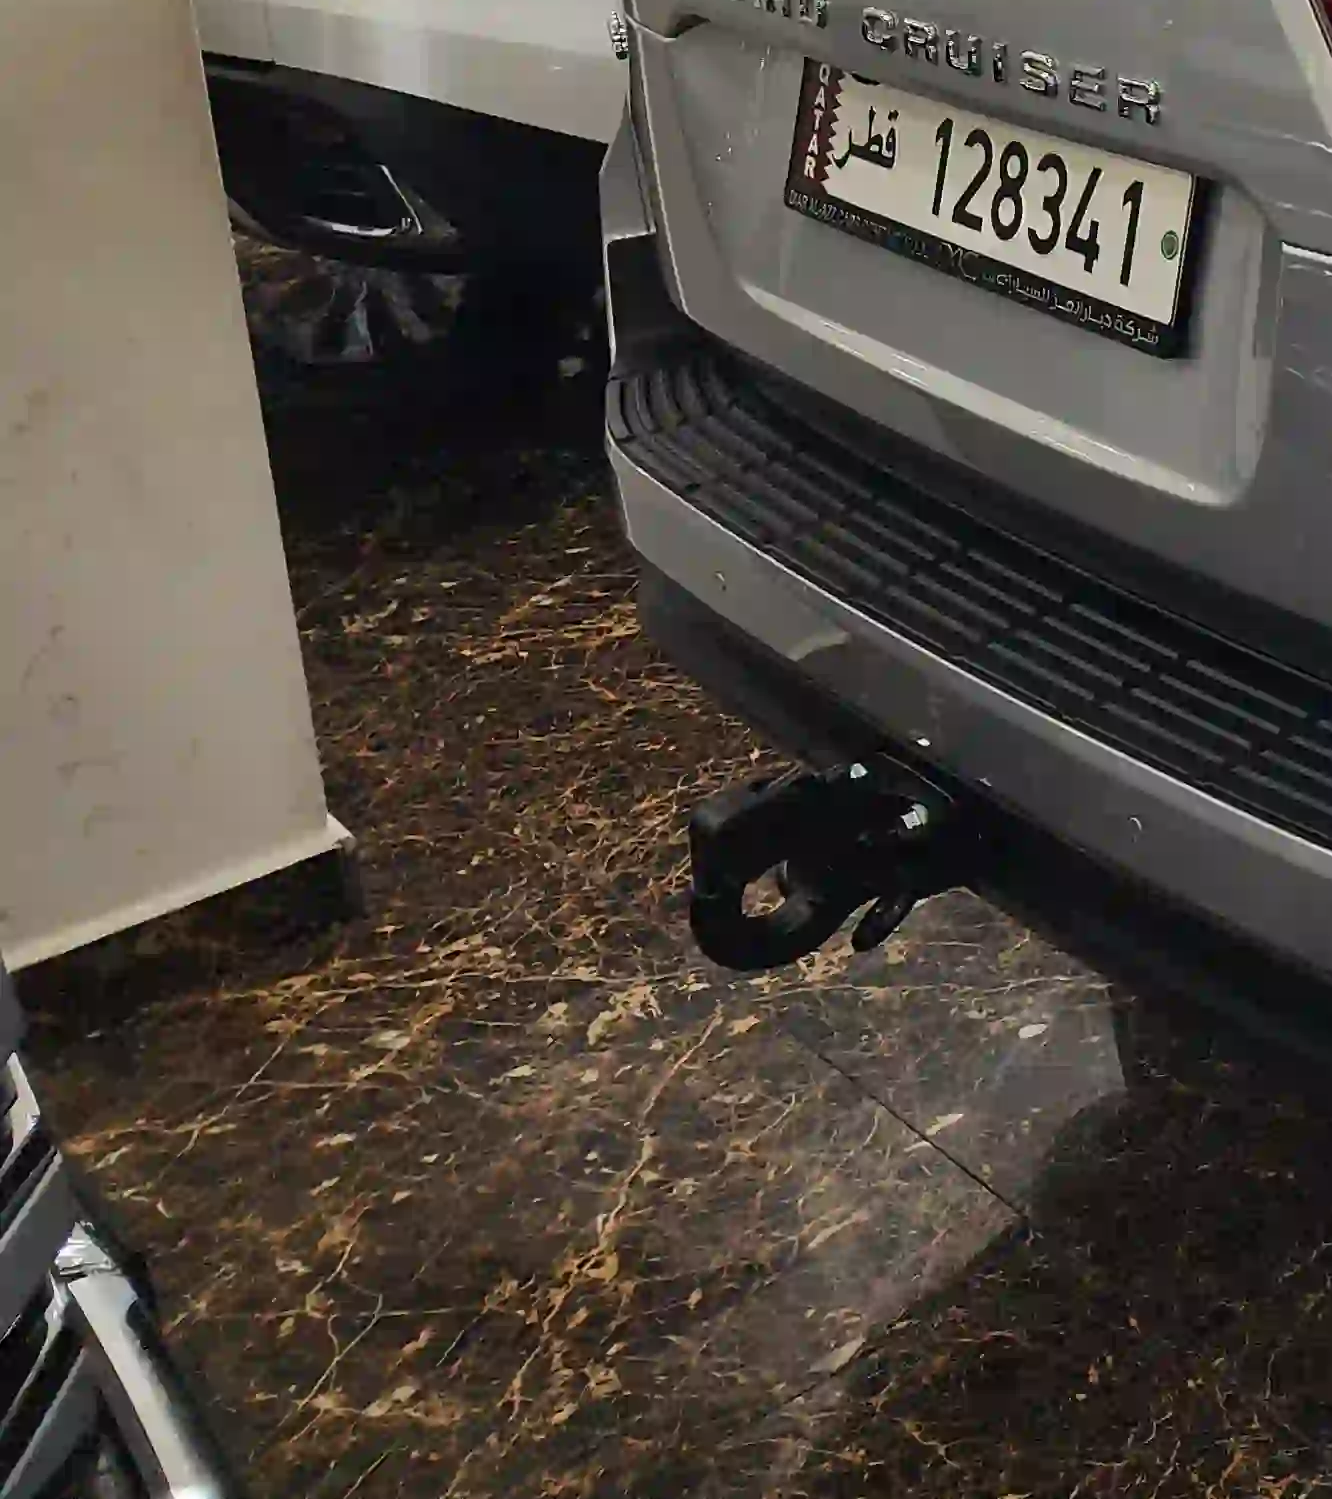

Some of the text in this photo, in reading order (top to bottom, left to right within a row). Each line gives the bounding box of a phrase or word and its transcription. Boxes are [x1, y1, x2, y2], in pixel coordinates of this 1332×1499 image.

[803, 63, 831, 179] QATAR
[861, 6, 1164, 125] CRUISER
[832, 105, 899, 170] قطر
[932, 117, 1144, 288] 128341
